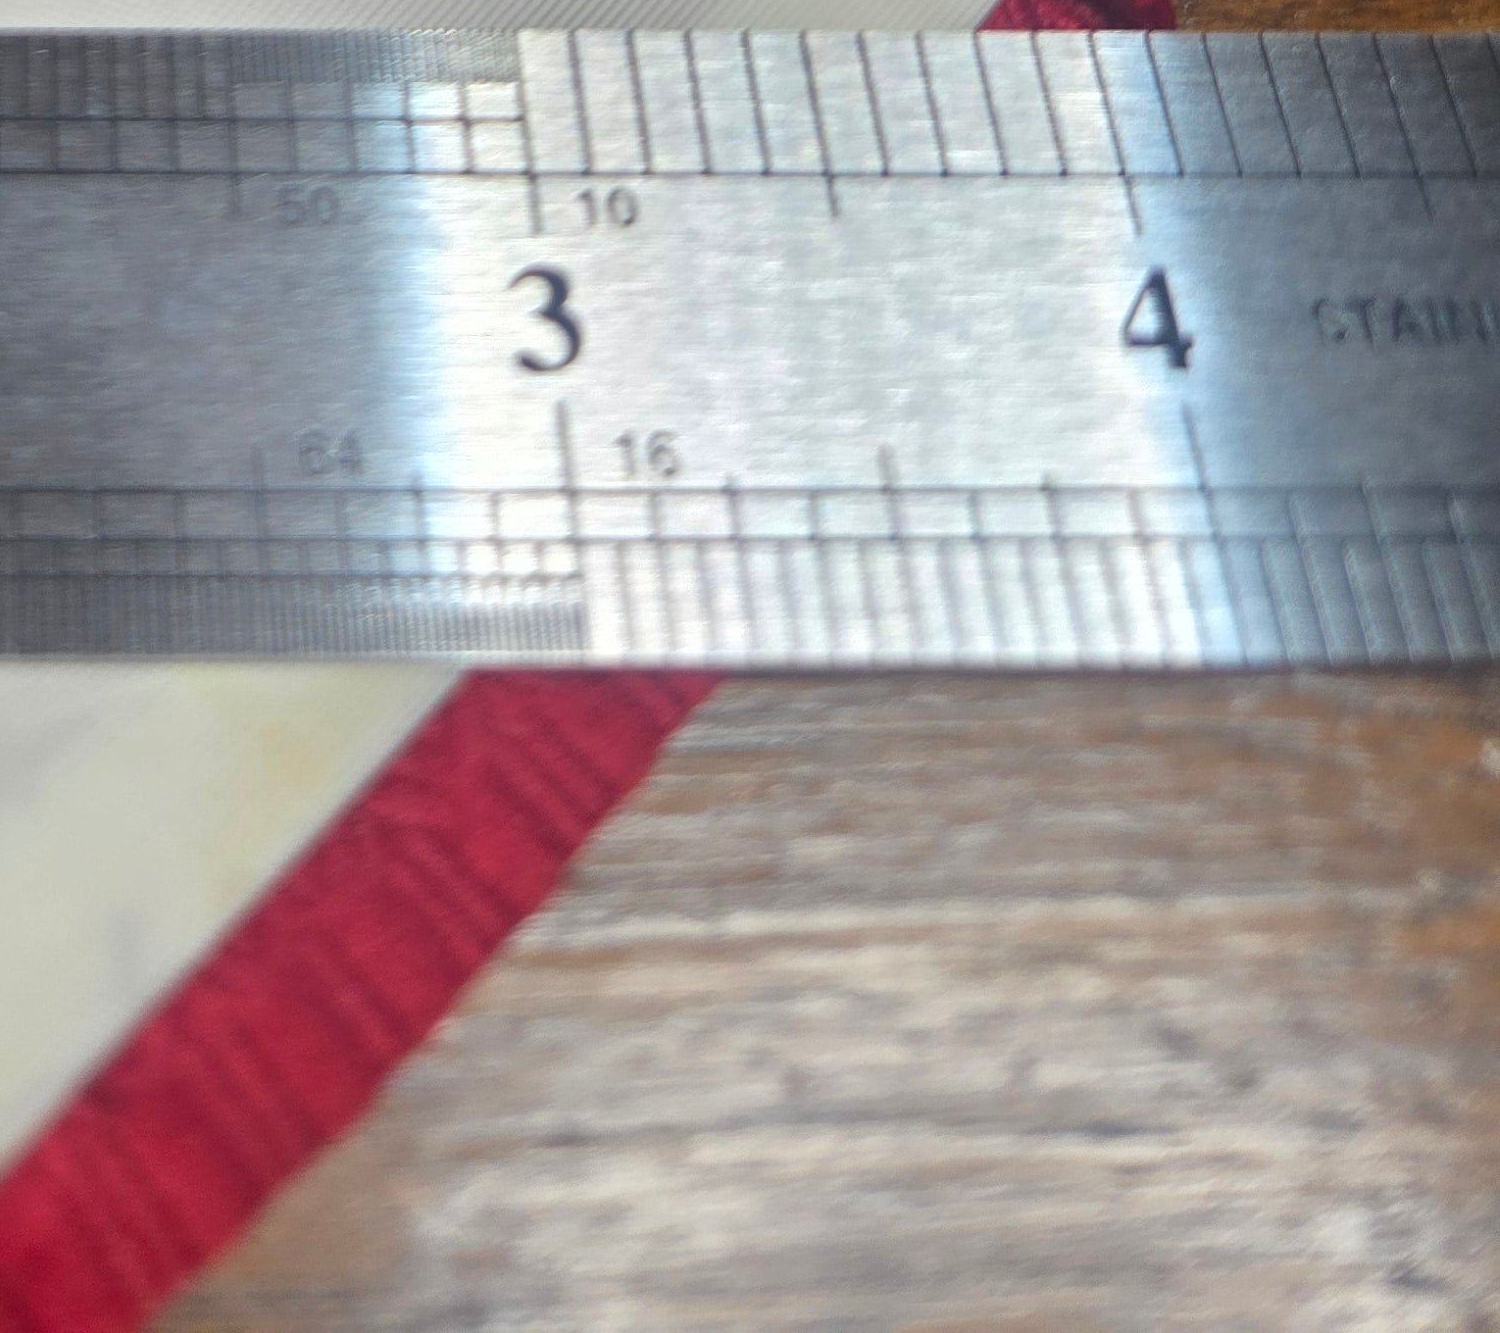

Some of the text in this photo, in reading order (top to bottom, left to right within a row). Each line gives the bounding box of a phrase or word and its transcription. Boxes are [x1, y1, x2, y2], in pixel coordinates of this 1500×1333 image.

[277, 186, 340, 226] 50
[577, 186, 639, 228] 10
[506, 263, 583, 372] 3
[1121, 265, 1194, 370] 4
[613, 429, 682, 477] 16
